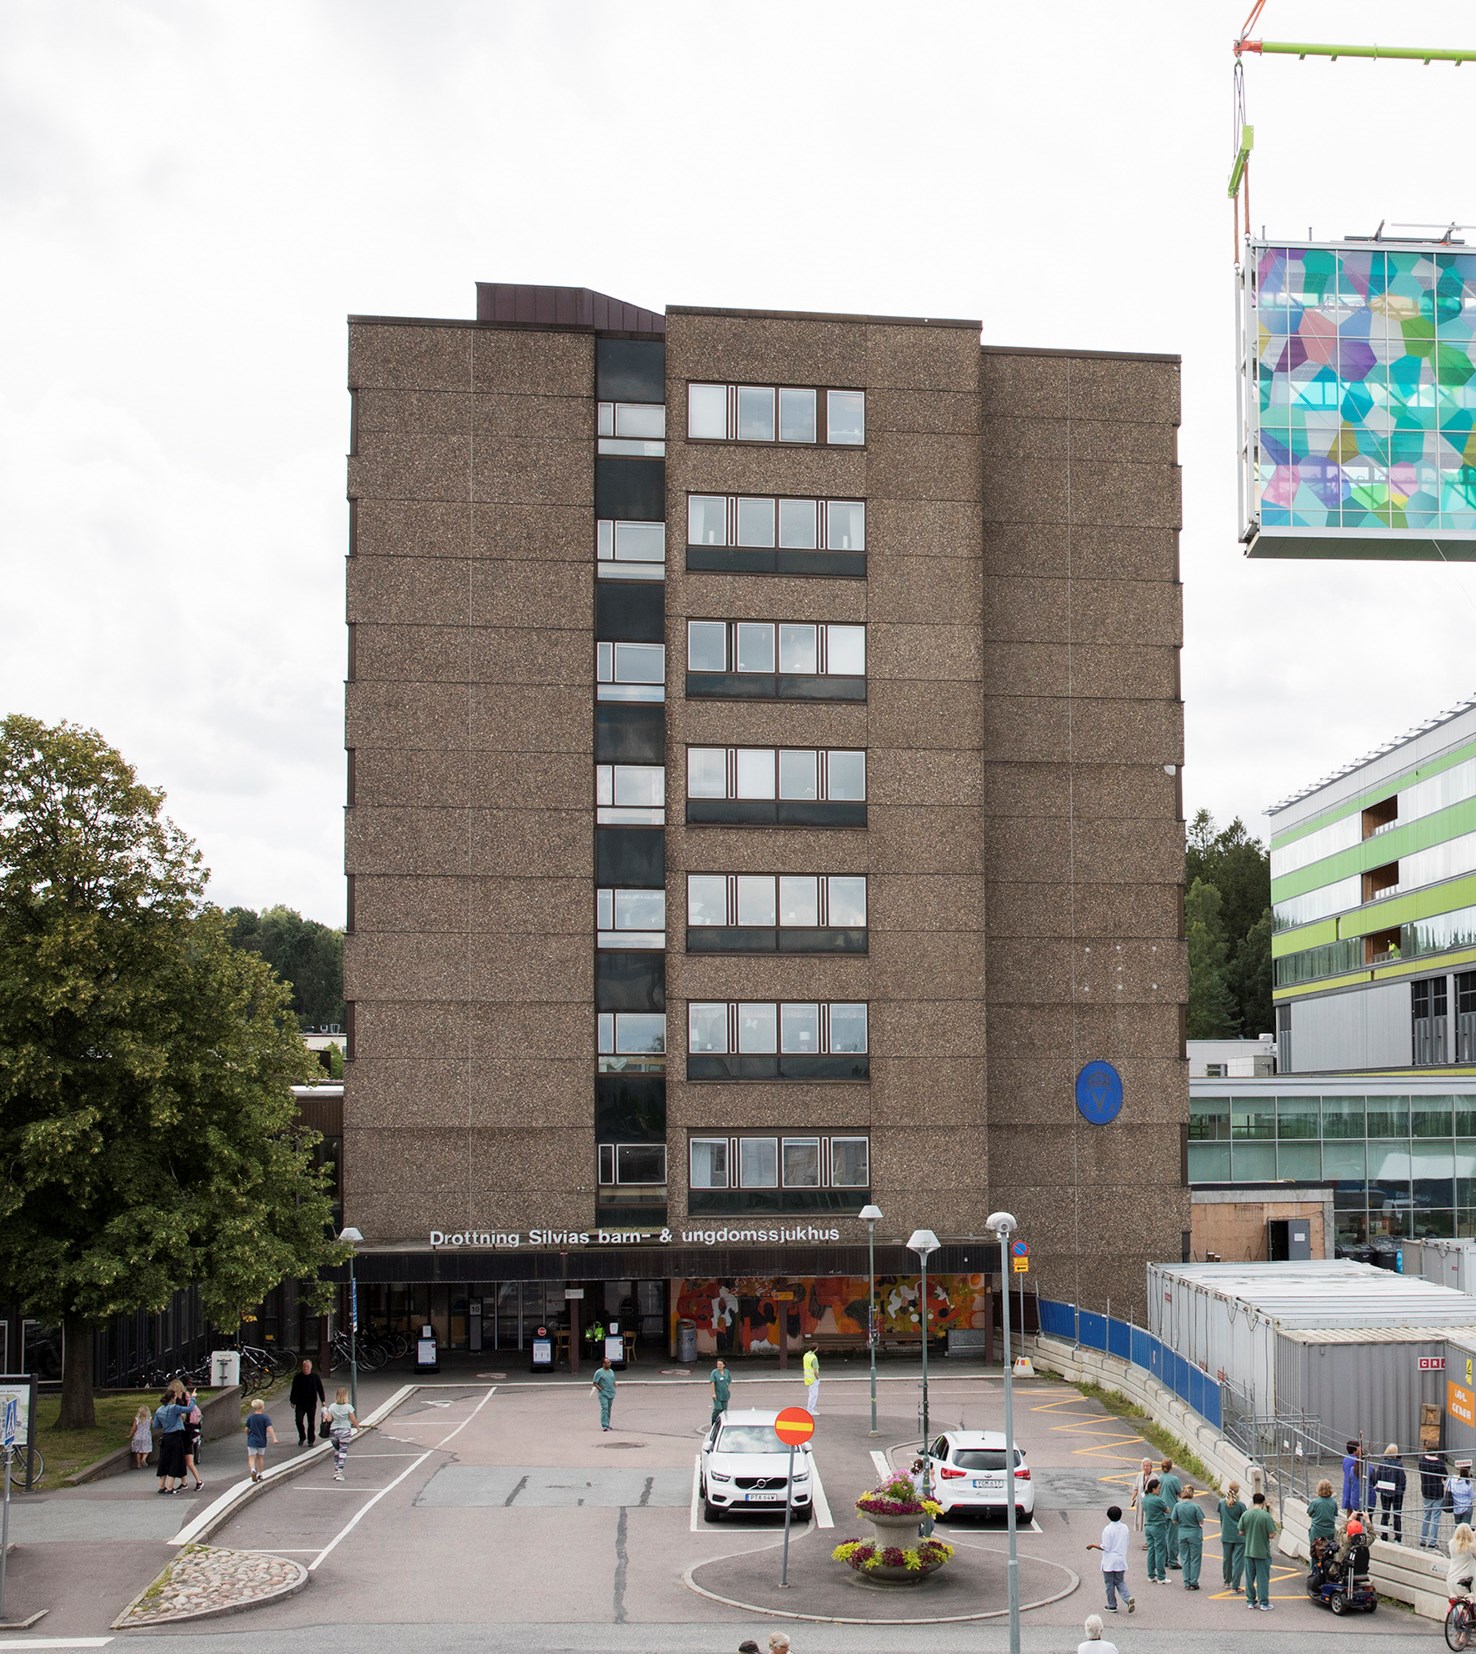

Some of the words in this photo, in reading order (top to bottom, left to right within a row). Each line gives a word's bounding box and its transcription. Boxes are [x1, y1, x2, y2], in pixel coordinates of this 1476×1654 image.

[430, 1230, 520, 1247] Drottning
[528, 1230, 590, 1245] Silvias
[598, 1230, 651, 1244] barn-
[659, 1228, 673, 1243] &
[682, 1226, 840, 1245] ungdomssjukhus
